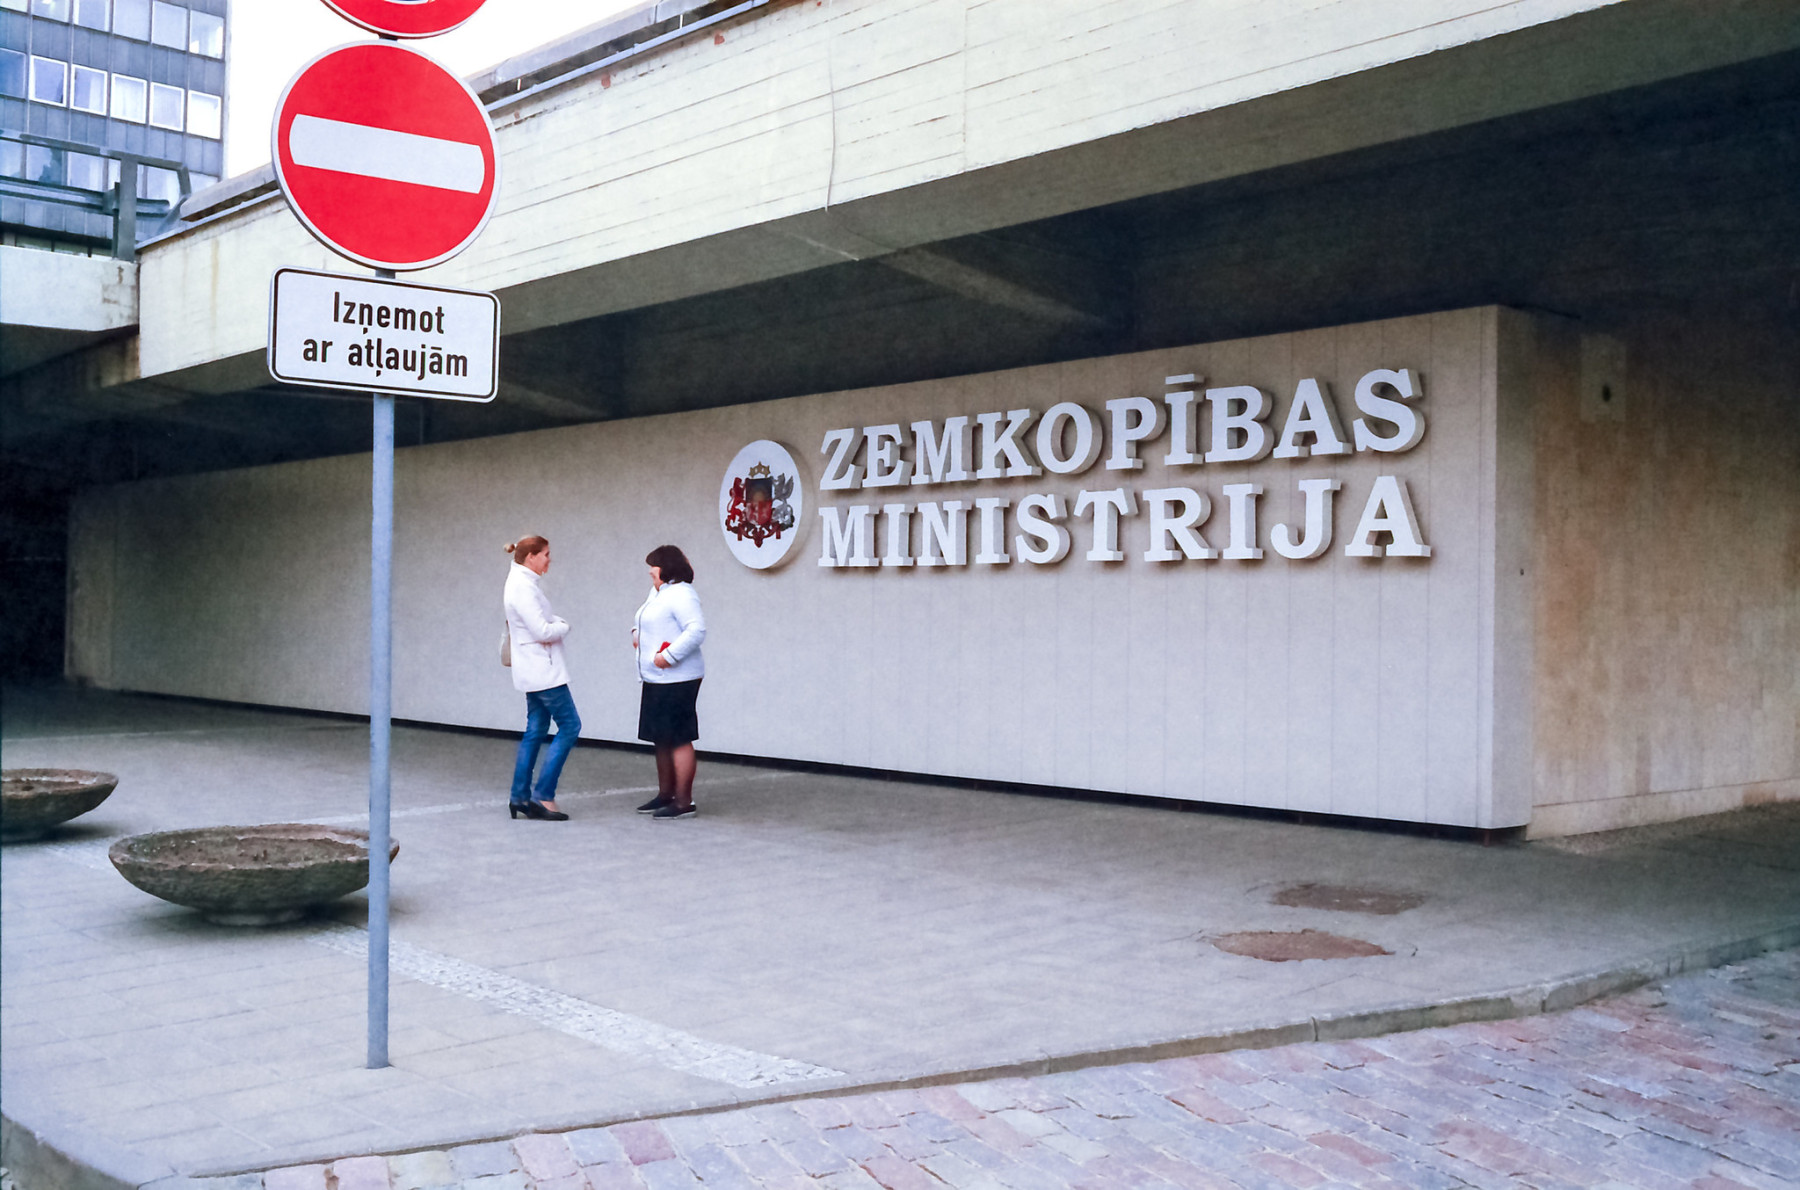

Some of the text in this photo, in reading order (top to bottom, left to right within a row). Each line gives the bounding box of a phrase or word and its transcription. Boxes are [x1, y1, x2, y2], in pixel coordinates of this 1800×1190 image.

[333, 291, 444, 335] Izņemot
[303, 338, 468, 381] ar atļaujām
[819, 368, 1424, 491] ZEMKOPĪBAS
[817, 475, 1431, 567] MINISTRIJA
